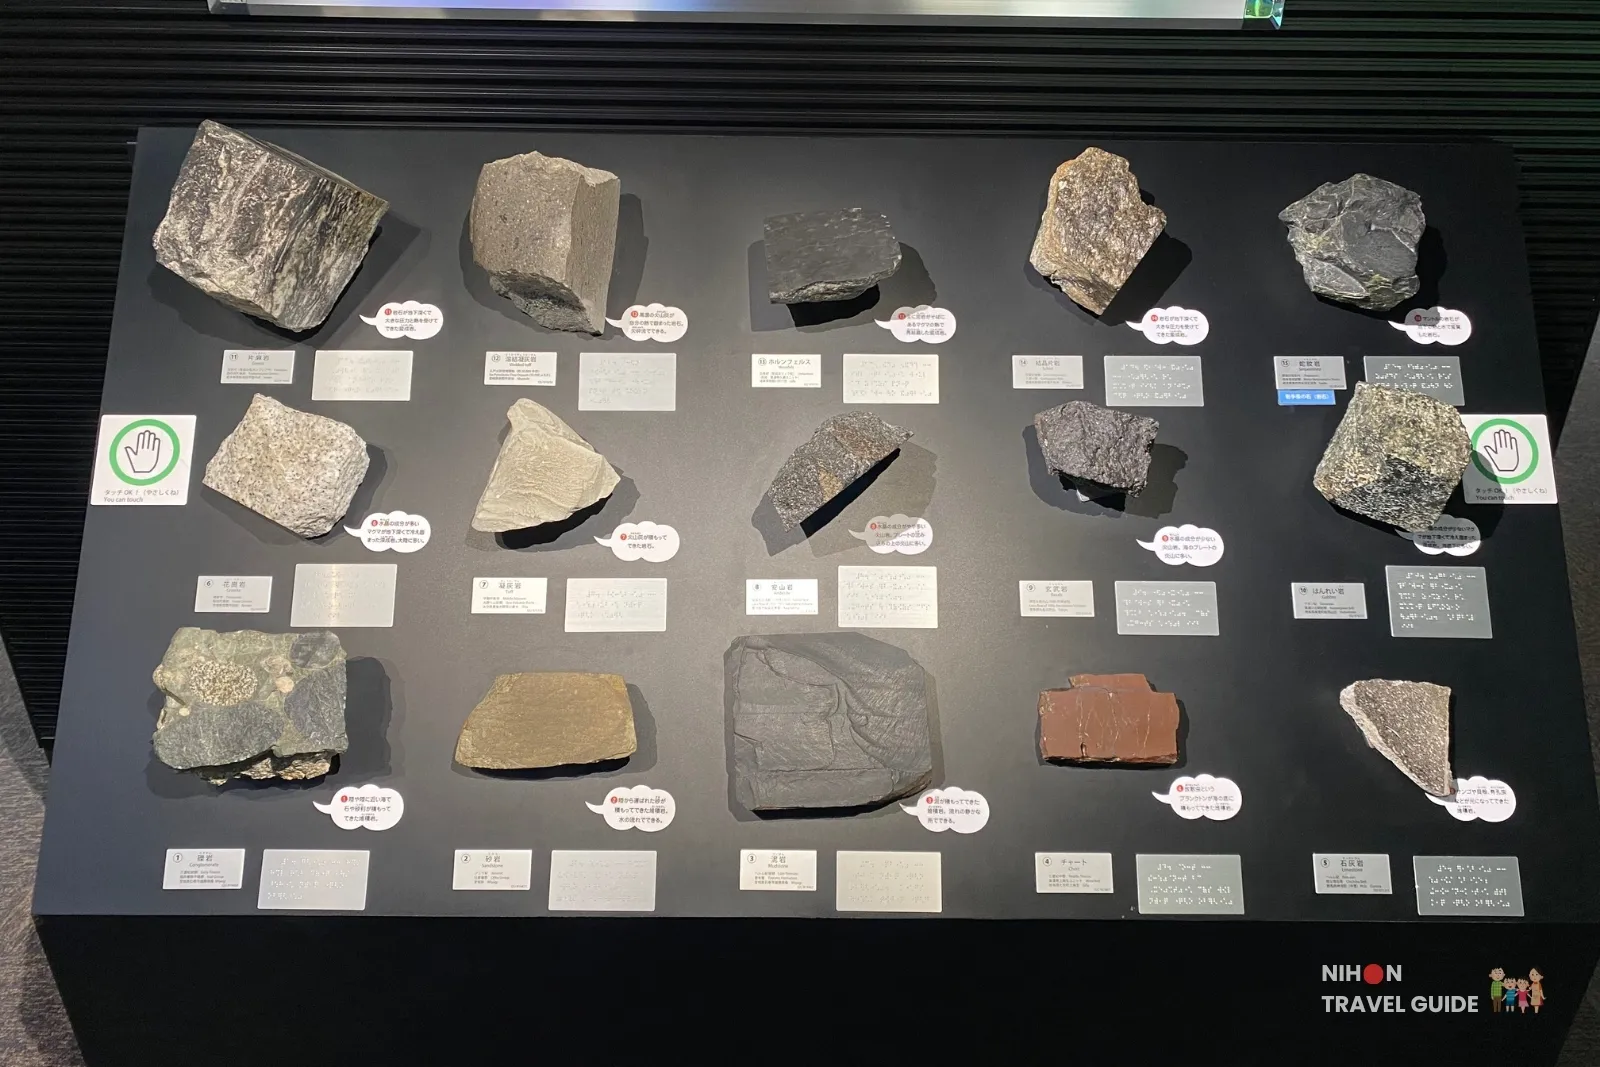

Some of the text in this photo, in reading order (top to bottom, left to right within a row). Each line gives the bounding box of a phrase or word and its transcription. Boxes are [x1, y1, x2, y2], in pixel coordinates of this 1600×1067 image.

[1312, 587, 1345, 595] はんれい岩
[771, 855, 787, 863] 泥岩
[1341, 859, 1364, 868] 石灰岩
